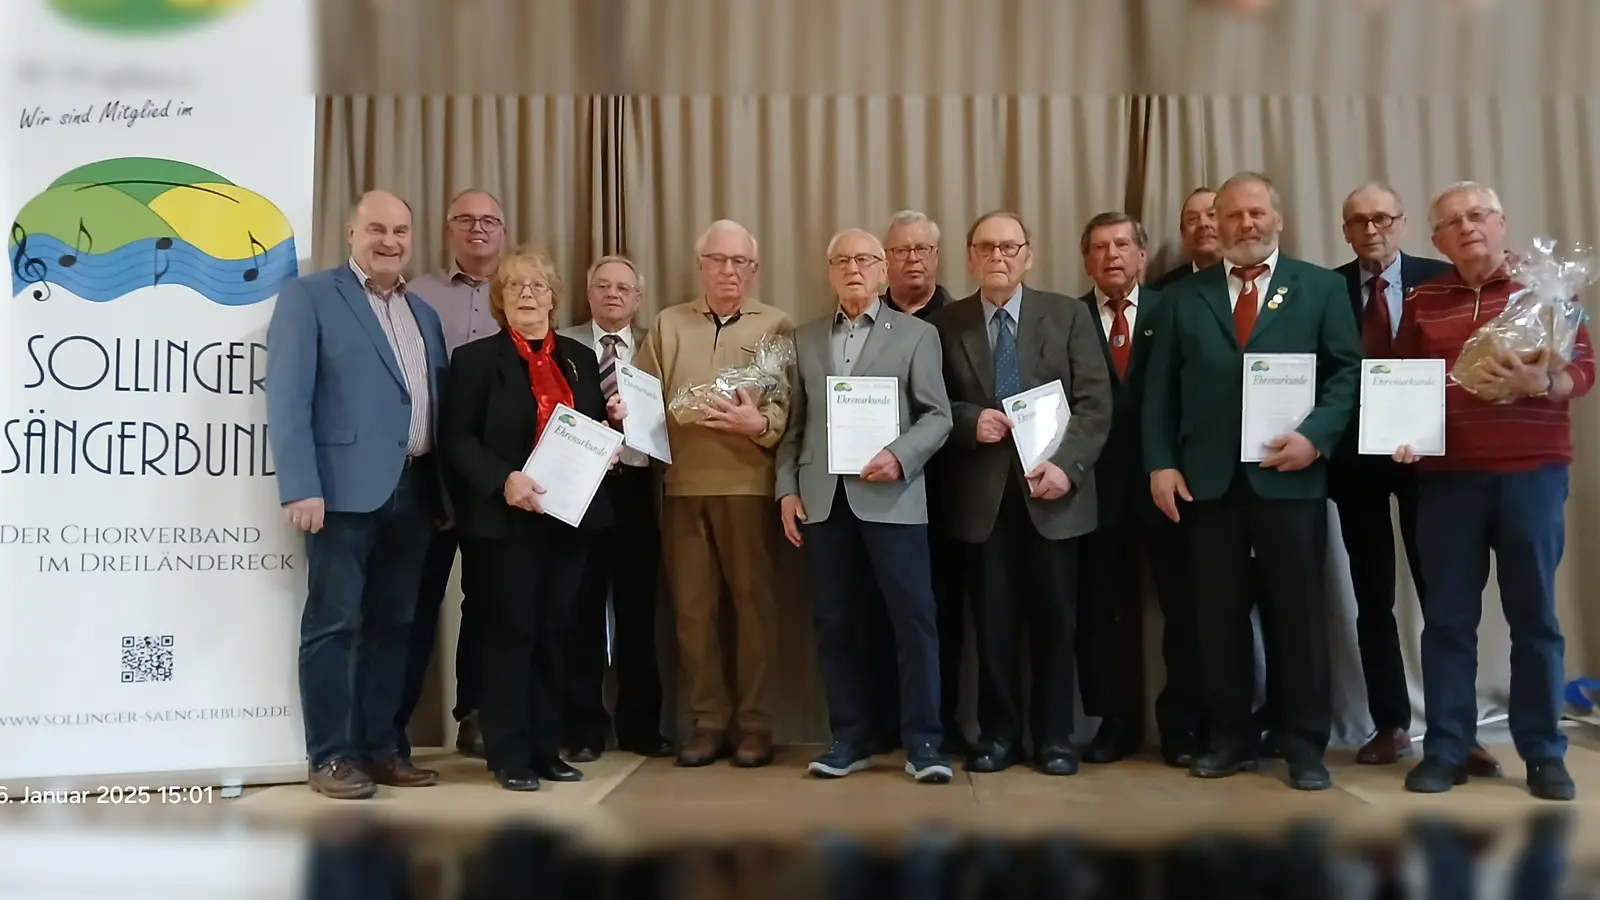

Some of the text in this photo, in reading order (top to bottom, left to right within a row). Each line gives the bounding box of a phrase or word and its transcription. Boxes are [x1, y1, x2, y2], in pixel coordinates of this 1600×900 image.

[20, 100, 193, 129] Wir sind Mitglied im
[24, 335, 268, 394] SOLLINGER
[554, 425, 608, 457] Ehrenurkunde
[0, 525, 261, 544] DER CHORVERBAND
[38, 552, 295, 572] IM DREILÄNDERECK
